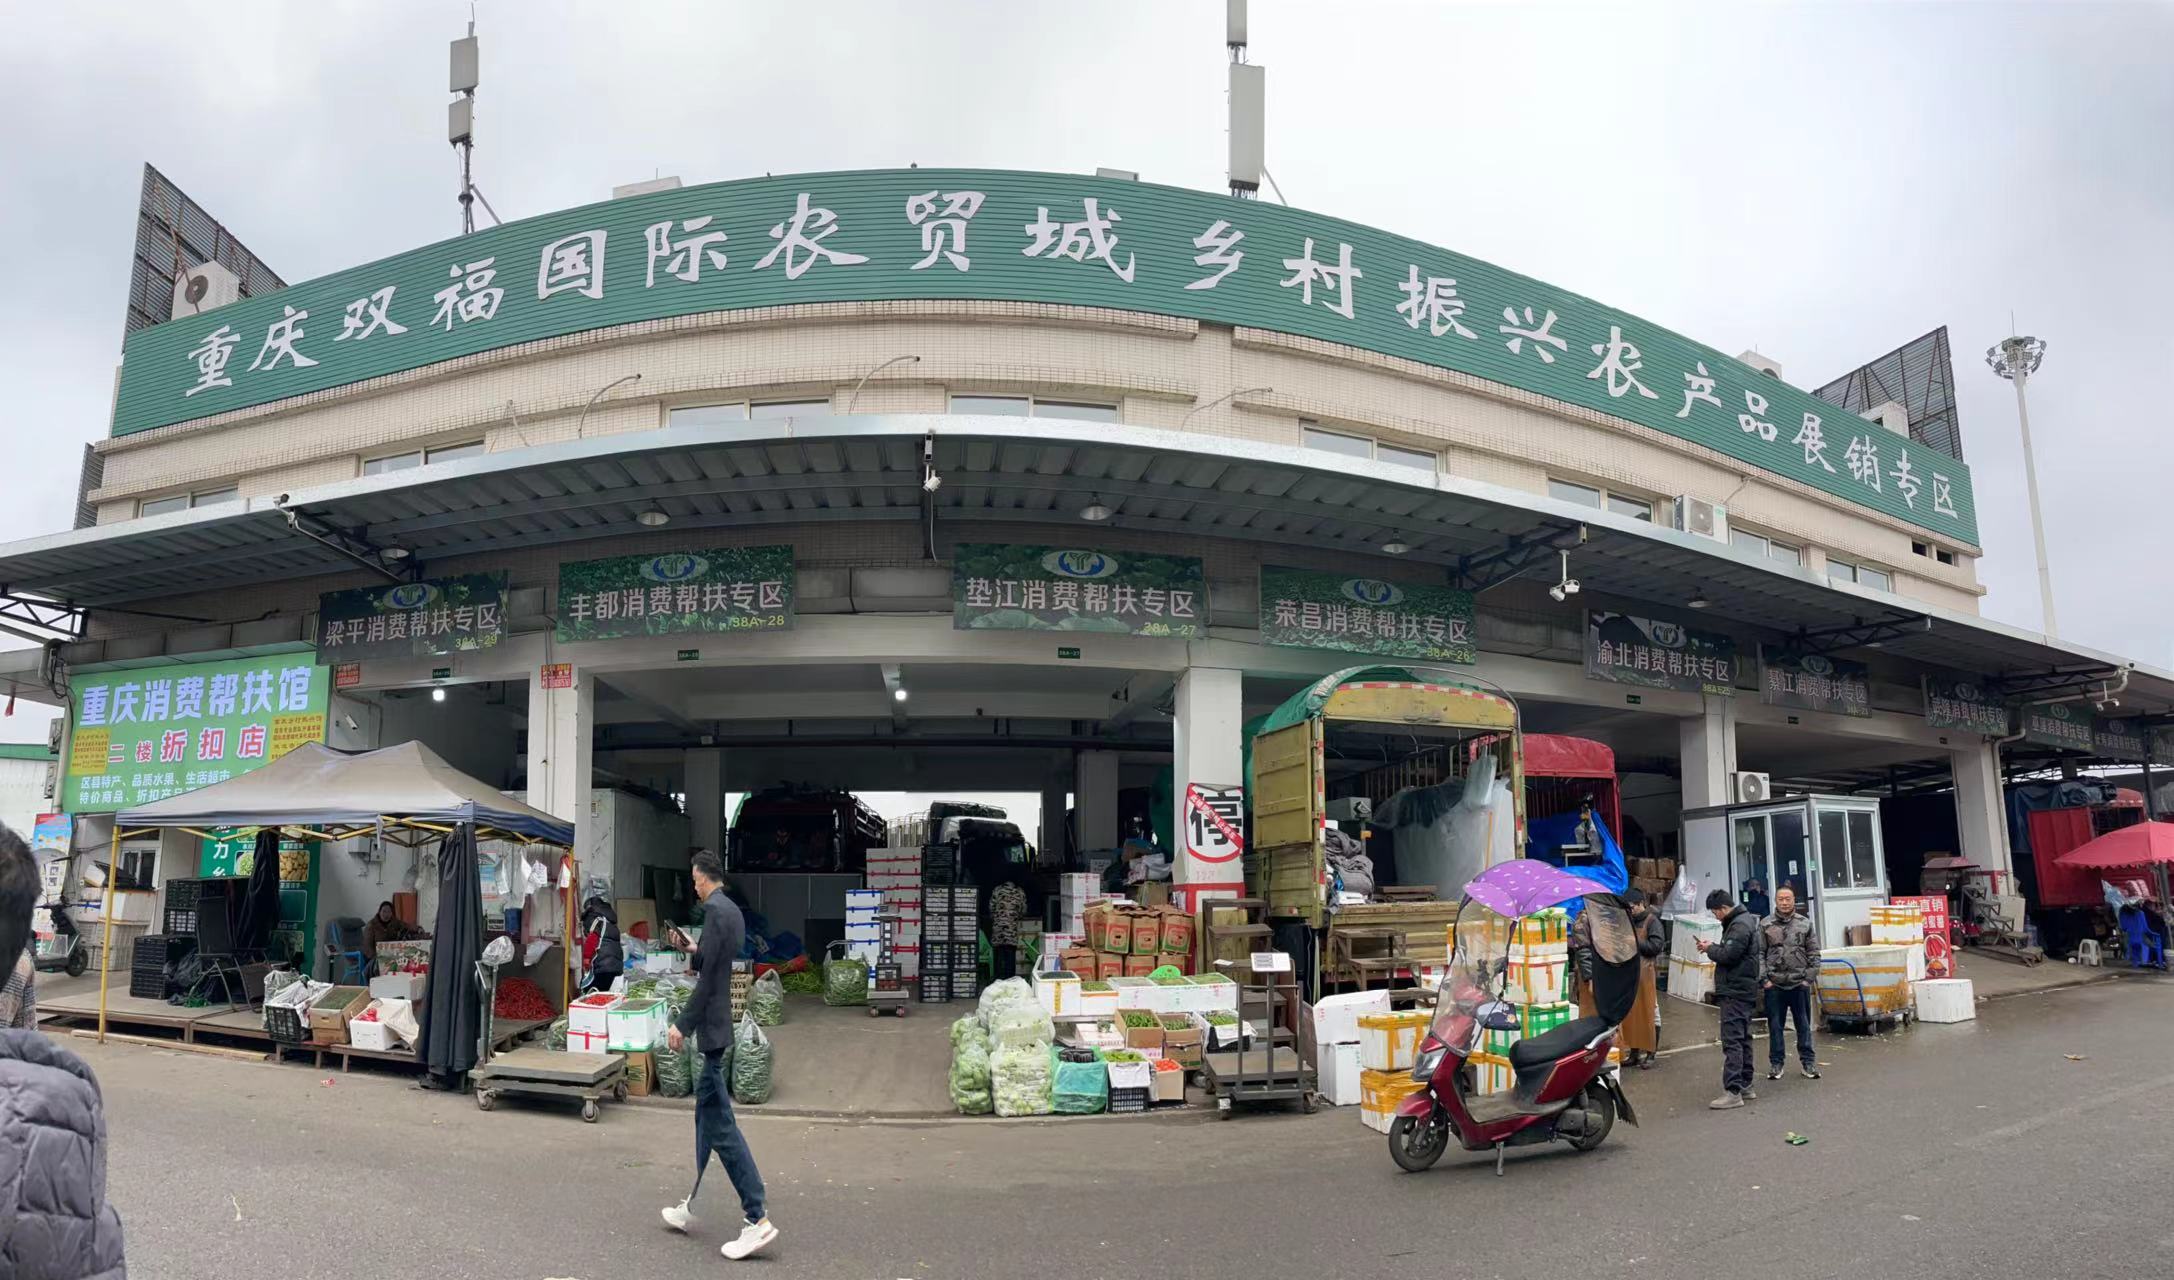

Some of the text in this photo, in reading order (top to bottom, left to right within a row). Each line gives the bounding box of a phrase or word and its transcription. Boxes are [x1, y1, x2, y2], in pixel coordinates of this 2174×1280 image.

[186, 189, 1959, 520] 重庆双福国际农贸城乡村振兴农产品展销专区
[569, 580, 784, 622] 丰都消费帮扶专区
[966, 577, 1195, 619] 垫江消费帮扶专区
[325, 602, 498, 647] 梁平消费帮扶专区
[732, 614, 785, 628] 38A-28
[1143, 622, 1197, 636] 38A-27
[1275, 599, 1469, 645] 荣昌消费帮扶专区
[1426, 647, 1470, 661] 38A-26
[1597, 640, 1729, 682] 渝北消费帮扶专区
[80, 667, 312, 726] 重庆消费帮扶馆
[108, 723, 266, 763] 二楼折扣店
[1190, 792, 1242, 846] 停
